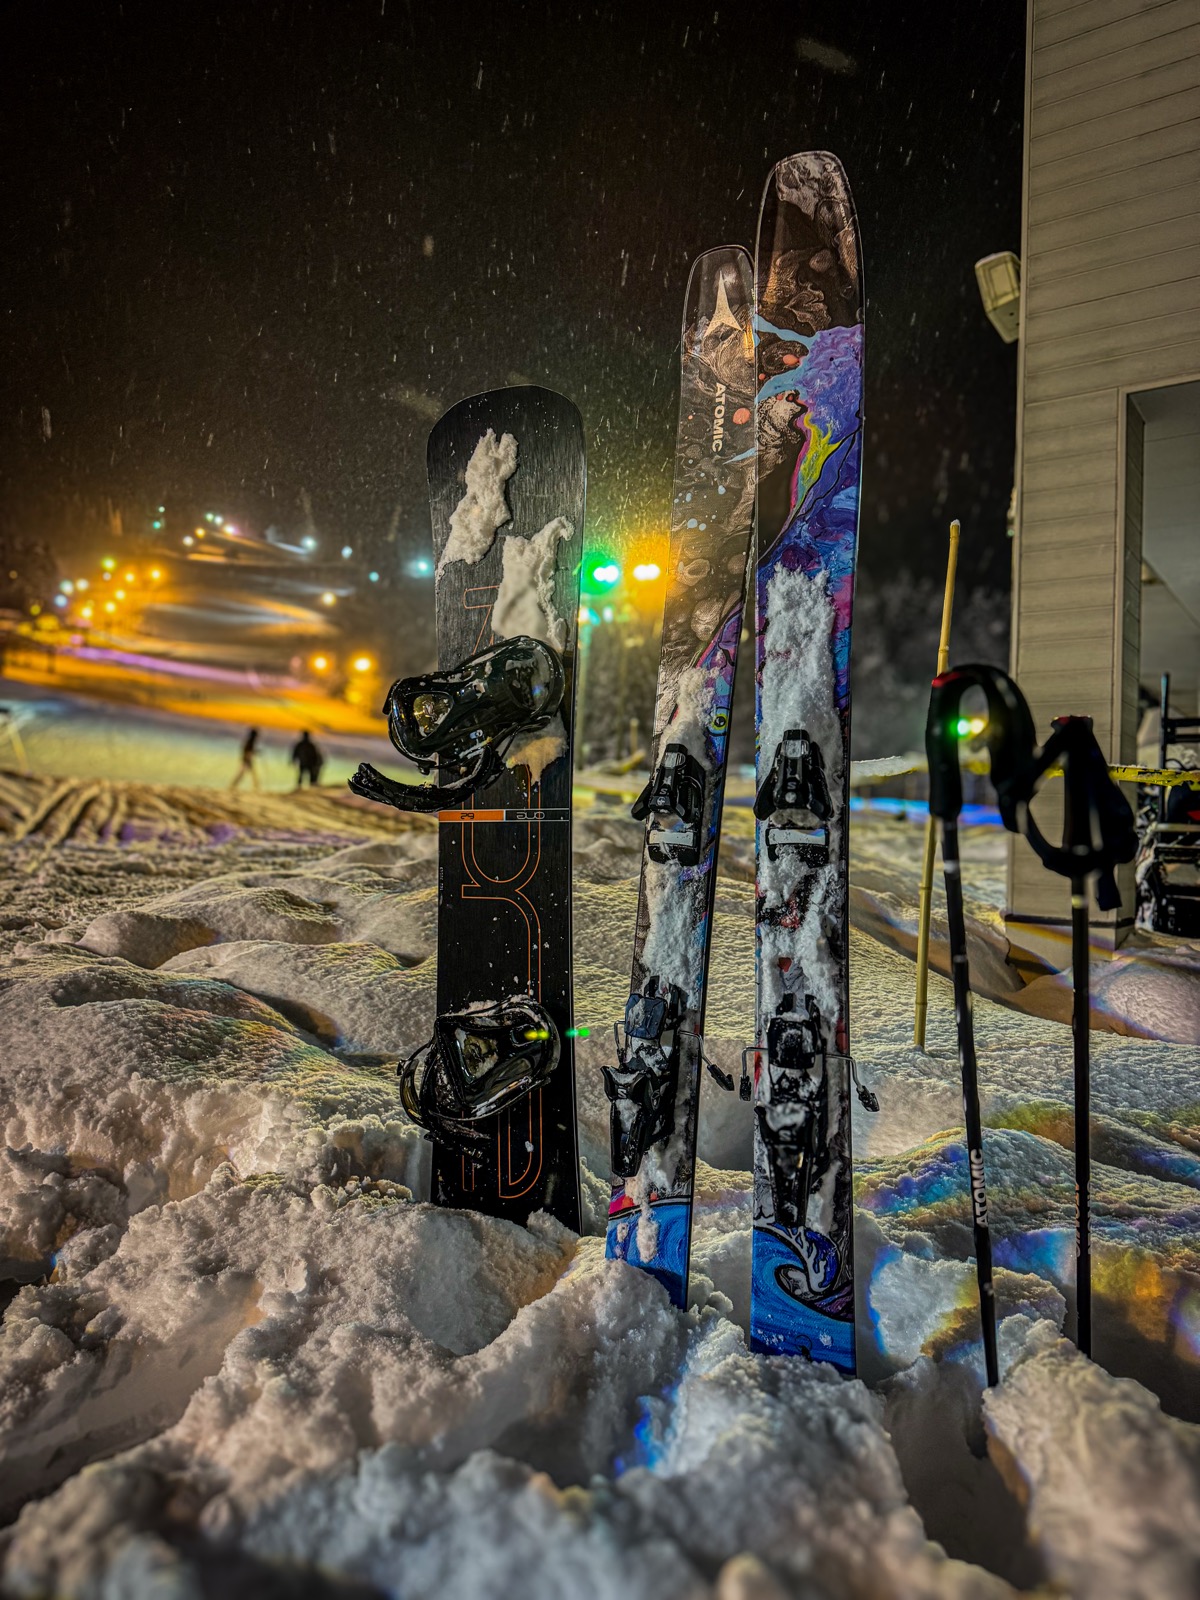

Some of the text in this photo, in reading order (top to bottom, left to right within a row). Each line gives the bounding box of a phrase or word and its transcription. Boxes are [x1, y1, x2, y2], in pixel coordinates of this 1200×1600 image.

[712, 383, 726, 452] ATOMIC
[516, 811, 546, 820] one
[970, 1148, 989, 1228] ATOMIC
